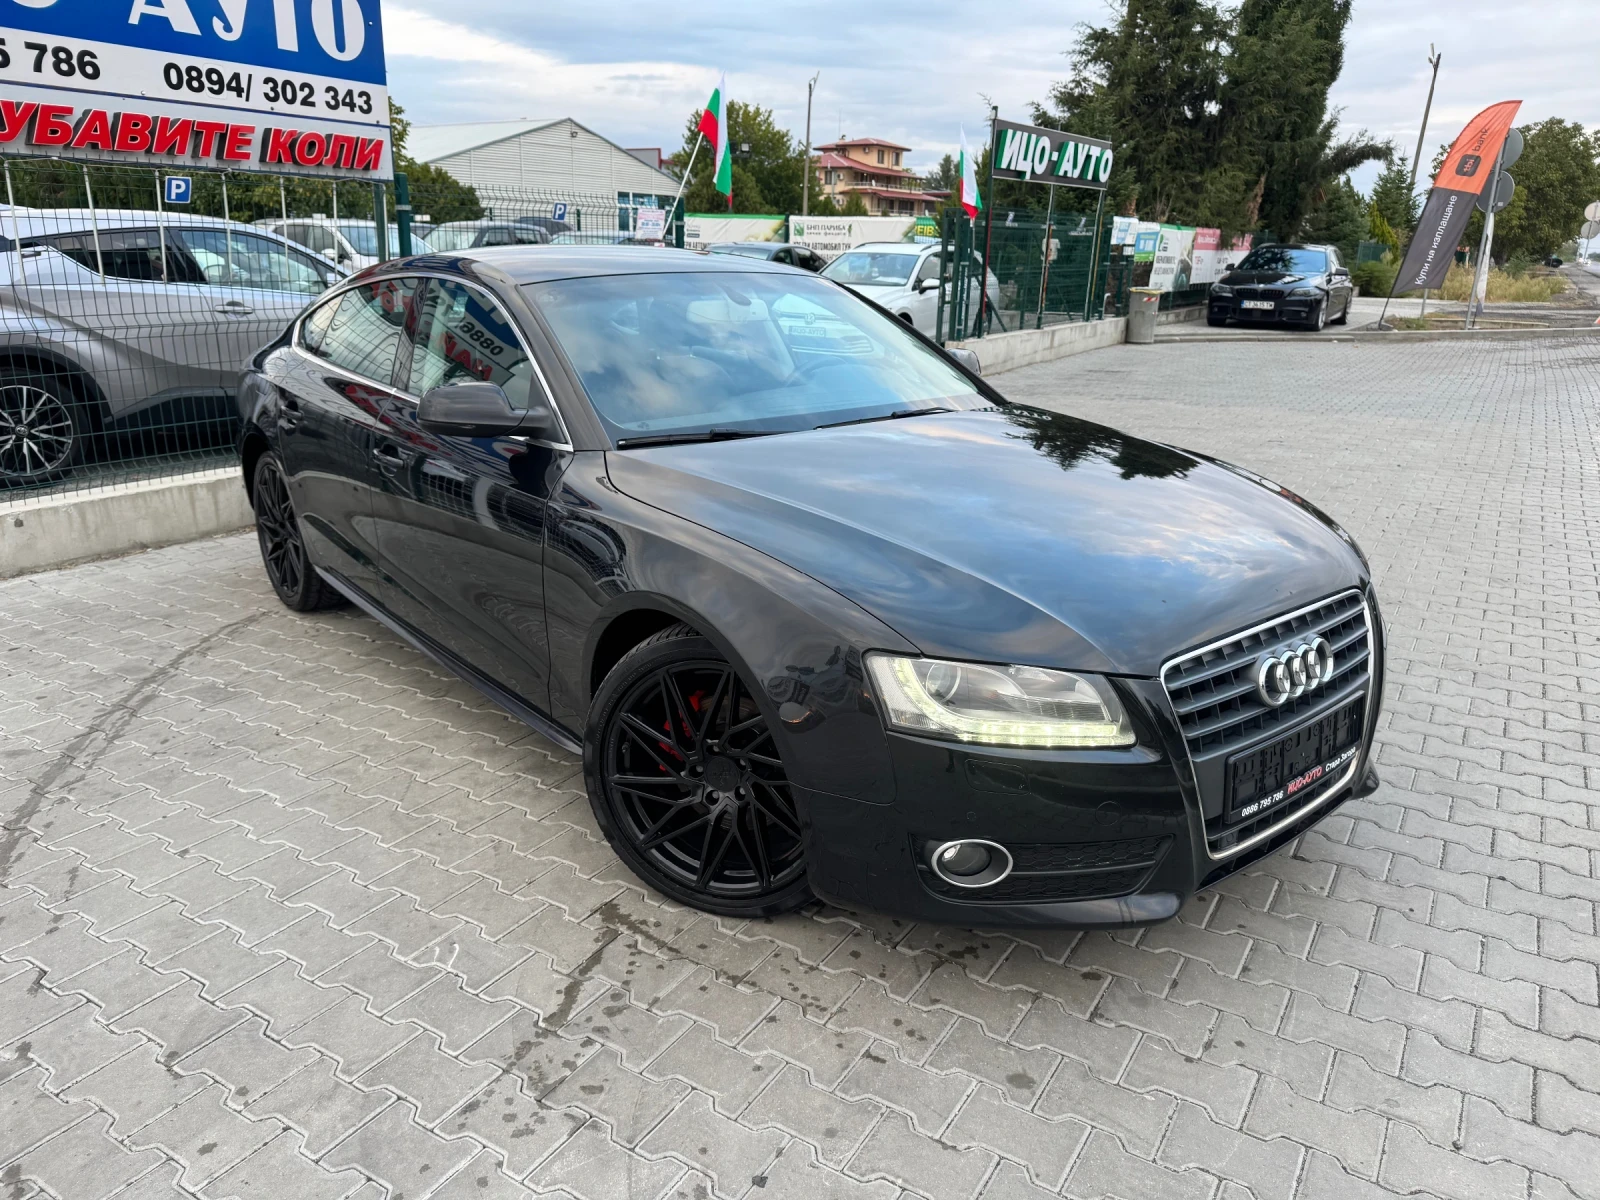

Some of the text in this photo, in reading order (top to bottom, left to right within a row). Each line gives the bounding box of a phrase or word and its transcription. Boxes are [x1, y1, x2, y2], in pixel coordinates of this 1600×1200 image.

[24, 41, 101, 80] 786
[163, 62, 253, 102] 0894/
[263, 76, 317, 108] 302
[325, 86, 373, 115] 343
[266, 128, 384, 171] КОЛИ
[1463, 128, 1488, 172] tbi bank
[171, 180, 185, 199] P
[1414, 195, 1458, 285] Купи на изплащане
[1241, 803, 1259, 817] 0886
[1260, 797, 1272, 809] 795
[1272, 790, 1284, 803] 786
[1325, 758, 1340, 772] Стара
